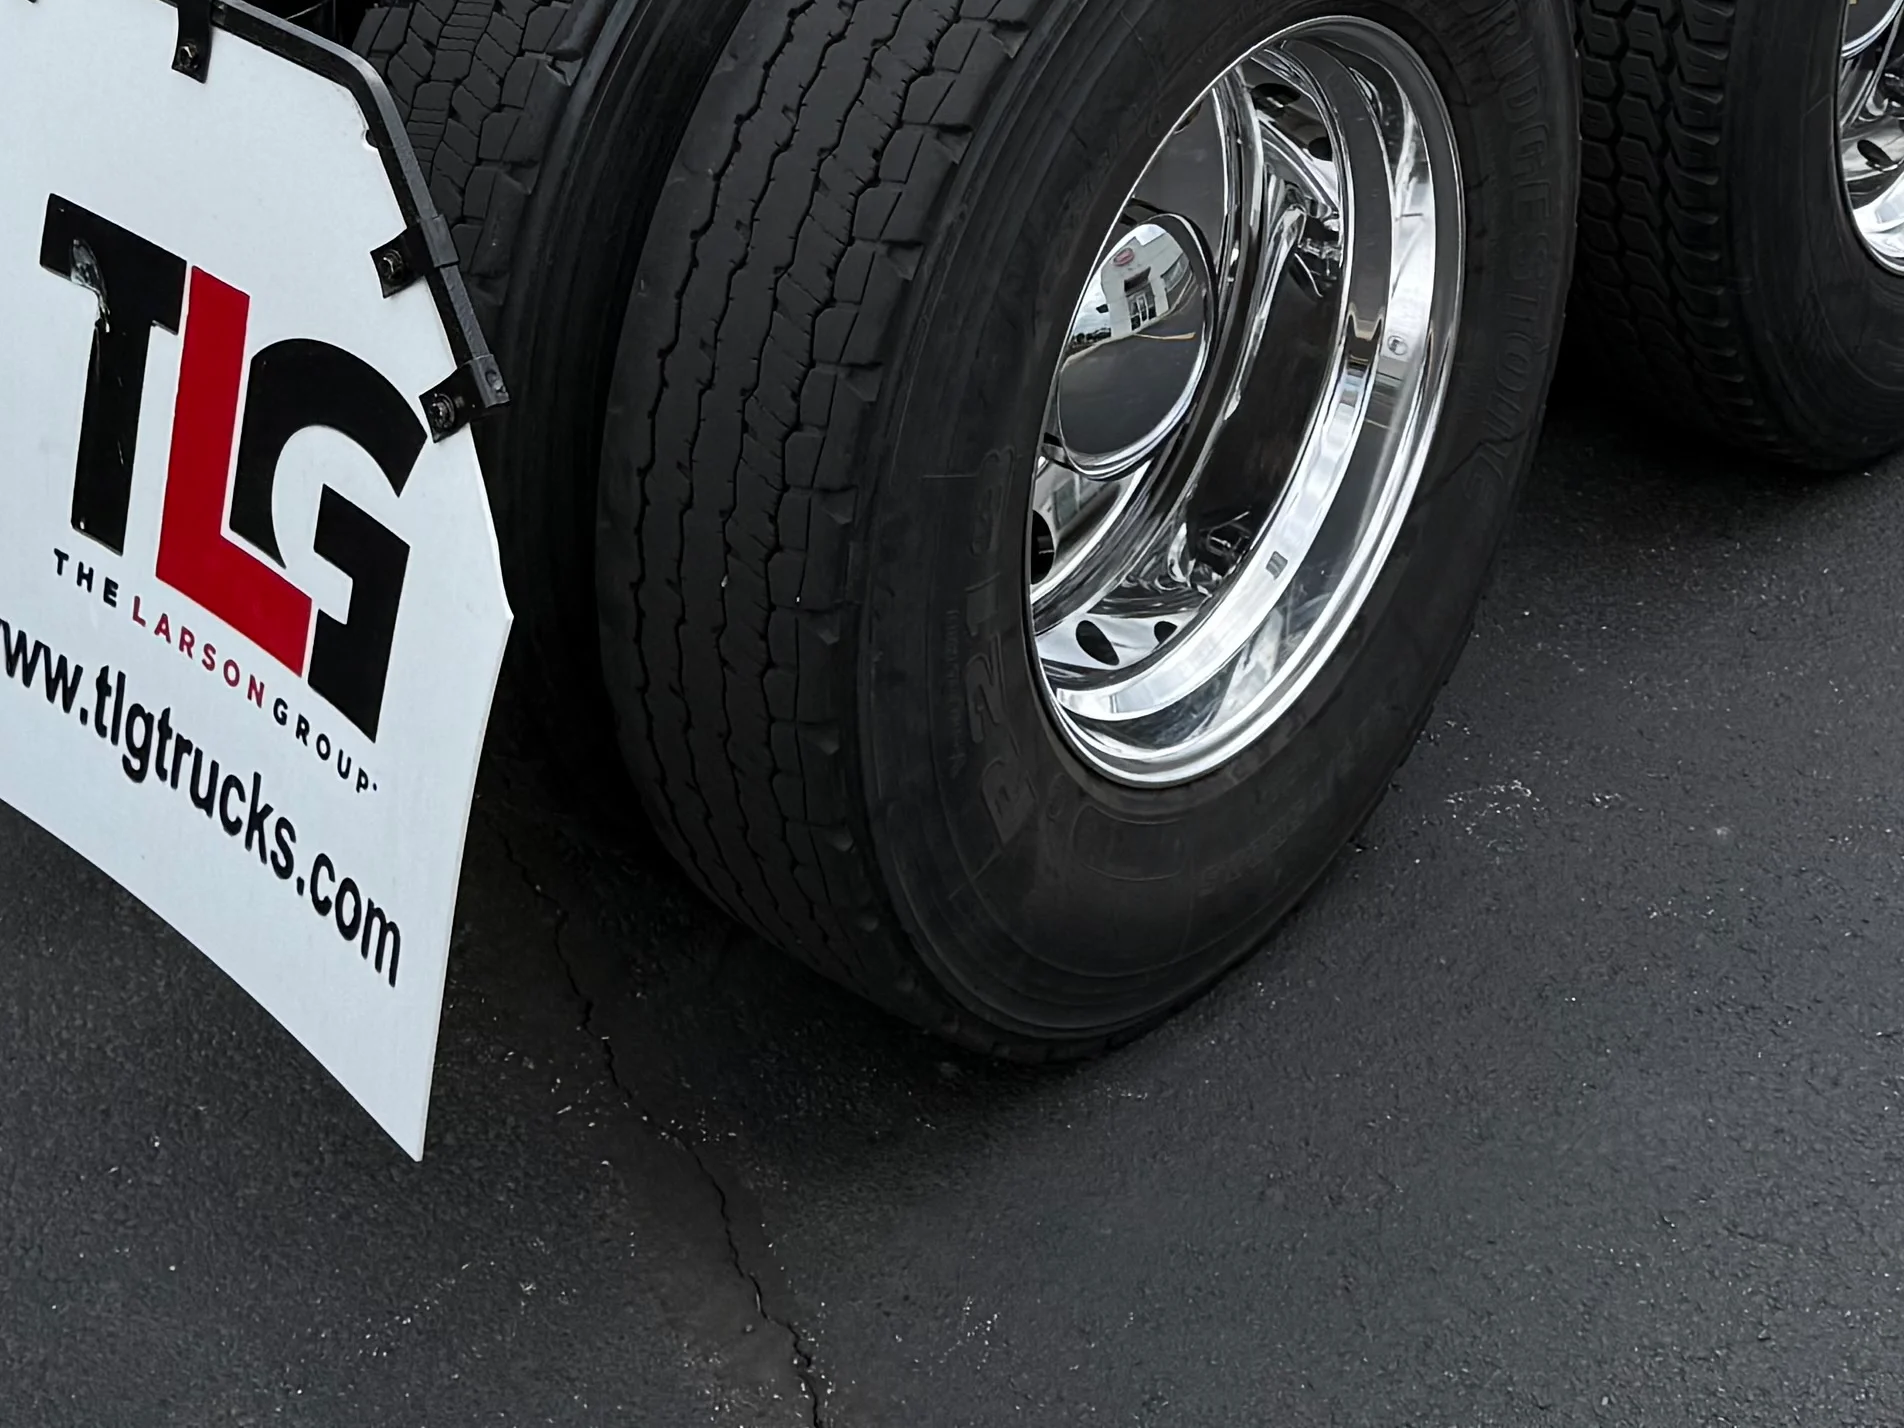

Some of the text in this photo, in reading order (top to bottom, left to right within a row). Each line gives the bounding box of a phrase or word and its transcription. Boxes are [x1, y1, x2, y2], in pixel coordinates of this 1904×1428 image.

[39, 193, 428, 744] TLG
[53, 548, 369, 793] THE LARSON GROUP
